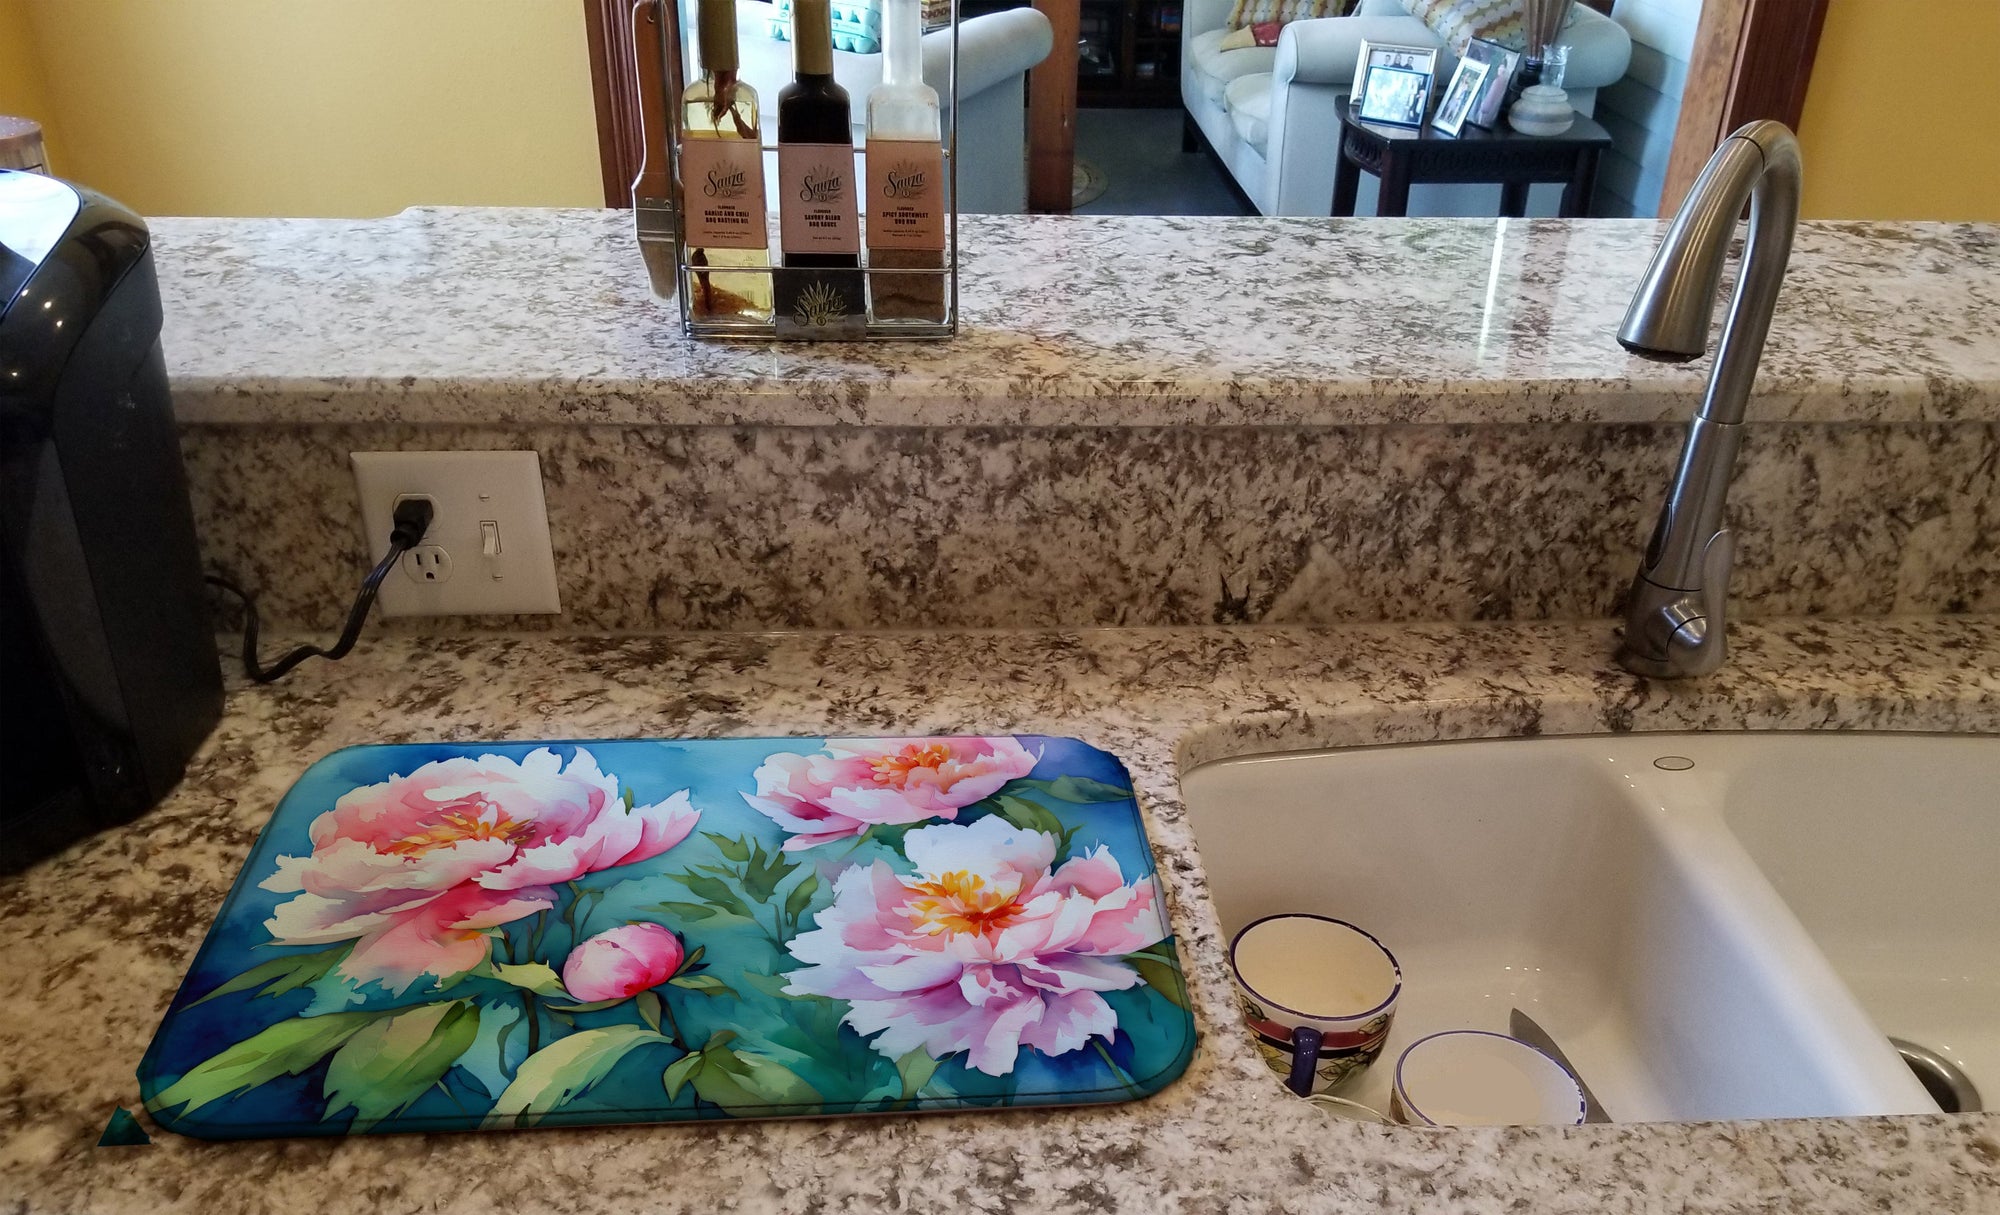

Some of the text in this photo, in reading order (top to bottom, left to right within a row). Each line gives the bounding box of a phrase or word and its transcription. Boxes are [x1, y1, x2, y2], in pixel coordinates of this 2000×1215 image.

[704, 169, 745, 197] Sauza
[800, 175, 841, 202] Sauza
[884, 171, 925, 198] Sauza
[792, 296, 845, 327] Sauza
